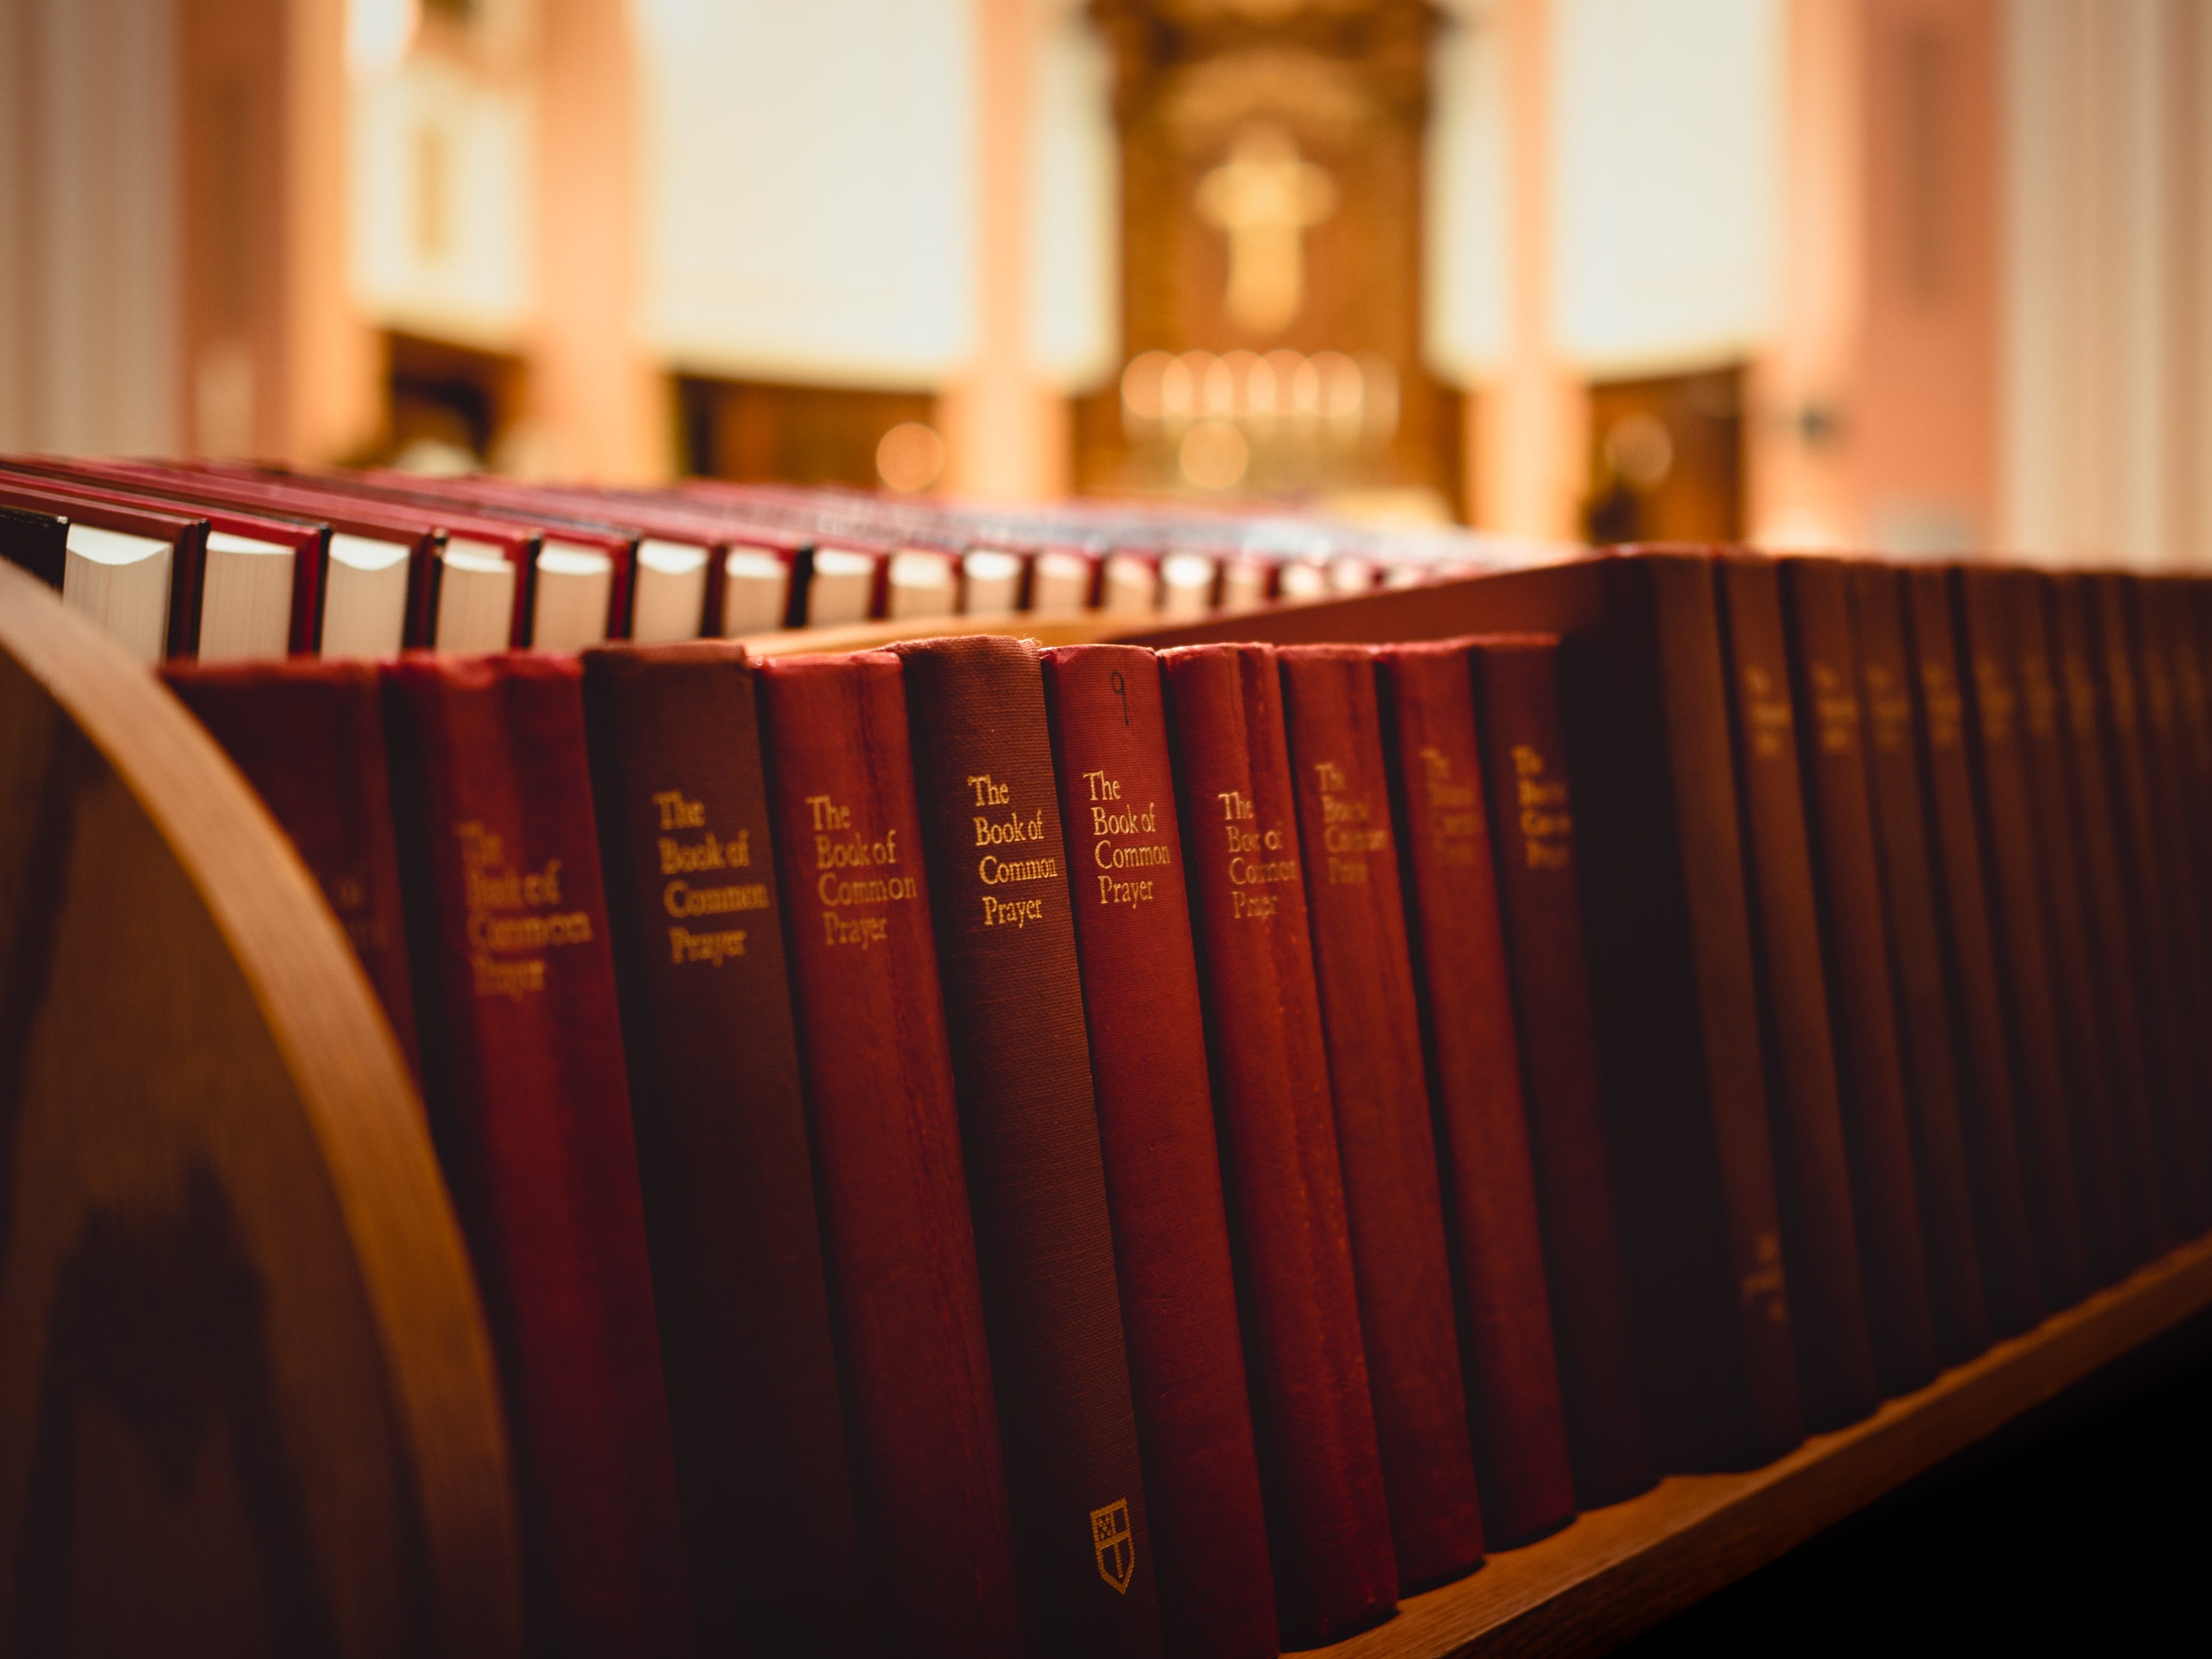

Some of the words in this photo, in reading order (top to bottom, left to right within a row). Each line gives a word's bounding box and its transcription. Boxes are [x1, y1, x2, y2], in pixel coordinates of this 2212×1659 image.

[967, 774, 1009, 807] The
[1083, 770, 1121, 801] The
[652, 789, 706, 831] The
[805, 794, 851, 831] The
[973, 811, 1026, 846] Book
[1028, 808, 1044, 840] of
[1090, 803, 1138, 835] Book
[1141, 802, 1156, 833] of
[657, 832, 726, 875] Book
[814, 831, 871, 870] Book
[873, 829, 897, 864] of
[1095, 840, 1171, 869] Common
[979, 855, 1058, 885] Common
[663, 880, 770, 918] Common
[818, 872, 917, 906] Common
[1098, 875, 1153, 910] Prayer
[982, 896, 1043, 928] Prayer
[669, 926, 747, 968] Prayer
[822, 911, 888, 951] Prayer
